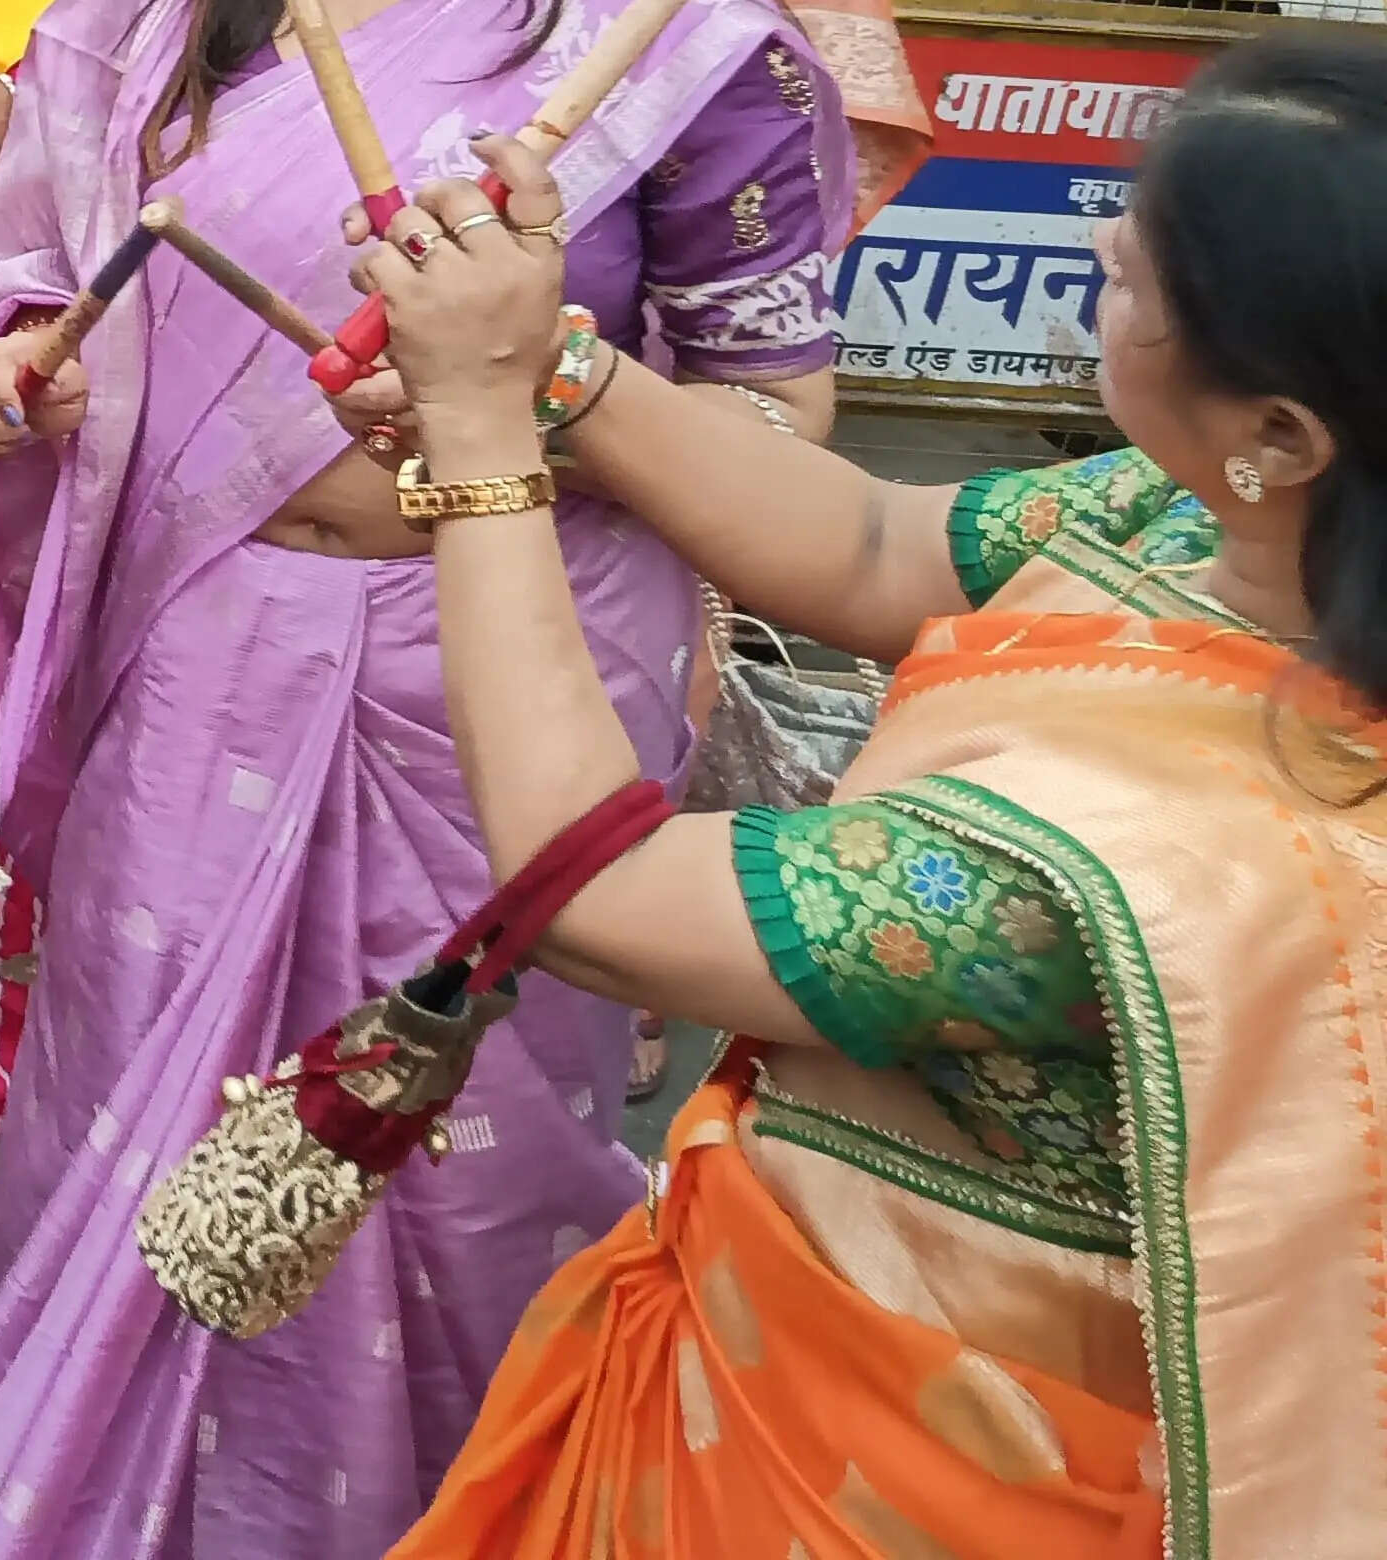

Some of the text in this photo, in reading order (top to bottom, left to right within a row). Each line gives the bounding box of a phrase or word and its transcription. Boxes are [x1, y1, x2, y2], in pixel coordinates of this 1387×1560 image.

[1068, 178, 1139, 214] कृप
[832, 234, 1107, 335] ारायन
[905, 340, 956, 377] एंड
